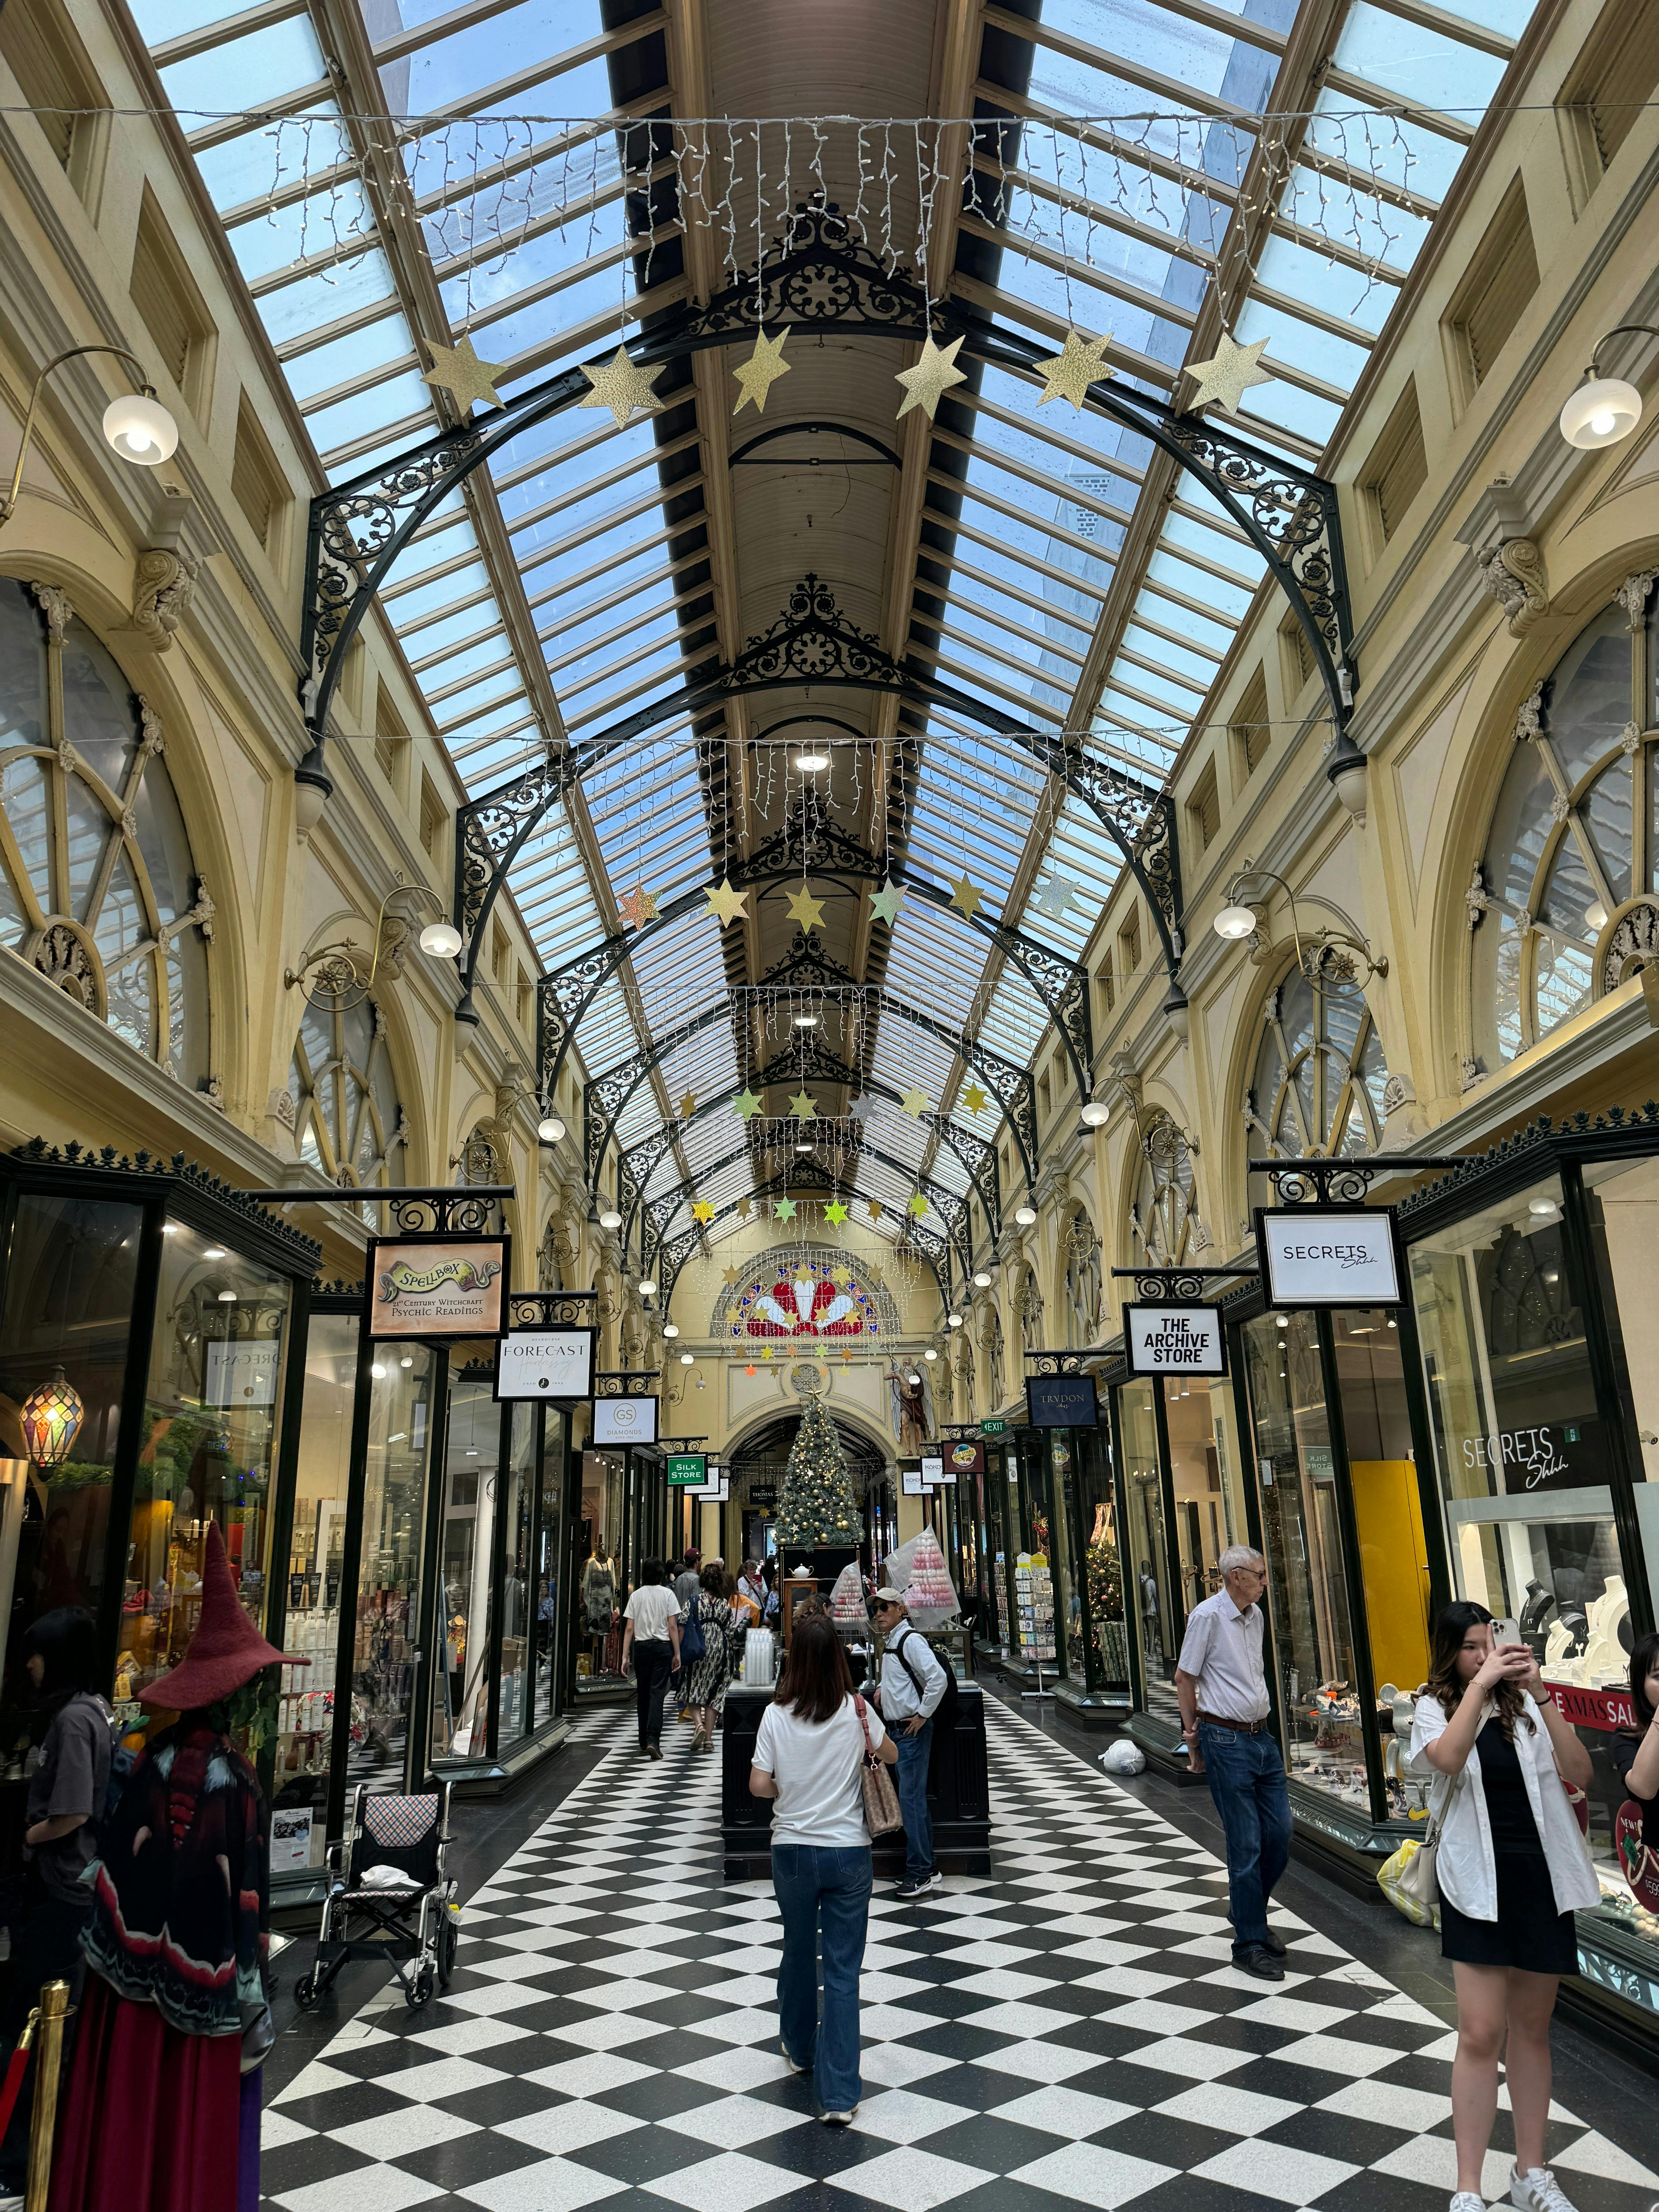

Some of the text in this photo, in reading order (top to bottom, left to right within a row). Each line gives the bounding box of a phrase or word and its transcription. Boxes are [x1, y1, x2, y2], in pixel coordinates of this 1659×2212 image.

[1283, 1245, 1367, 1259] SECRETS
[1341, 1254, 1379, 1269] Shhh
[1161, 1318, 1190, 1332] THE
[1144, 1333, 1209, 1348] ARCHIVE
[504, 1345, 586, 1356] FORECAST
[1153, 1348, 1202, 1363] STORE
[617, 1410, 633, 1420] GS
[988, 1422, 1003, 1431] EXIT
[1463, 1427, 1553, 1468] SECRETS
[1525, 1450, 1568, 1489] Shhh
[1563, 1693, 1607, 1721] XMAS
[1607, 1700, 1638, 1727] SAL
[1620, 1817, 1637, 1831] NEW!
